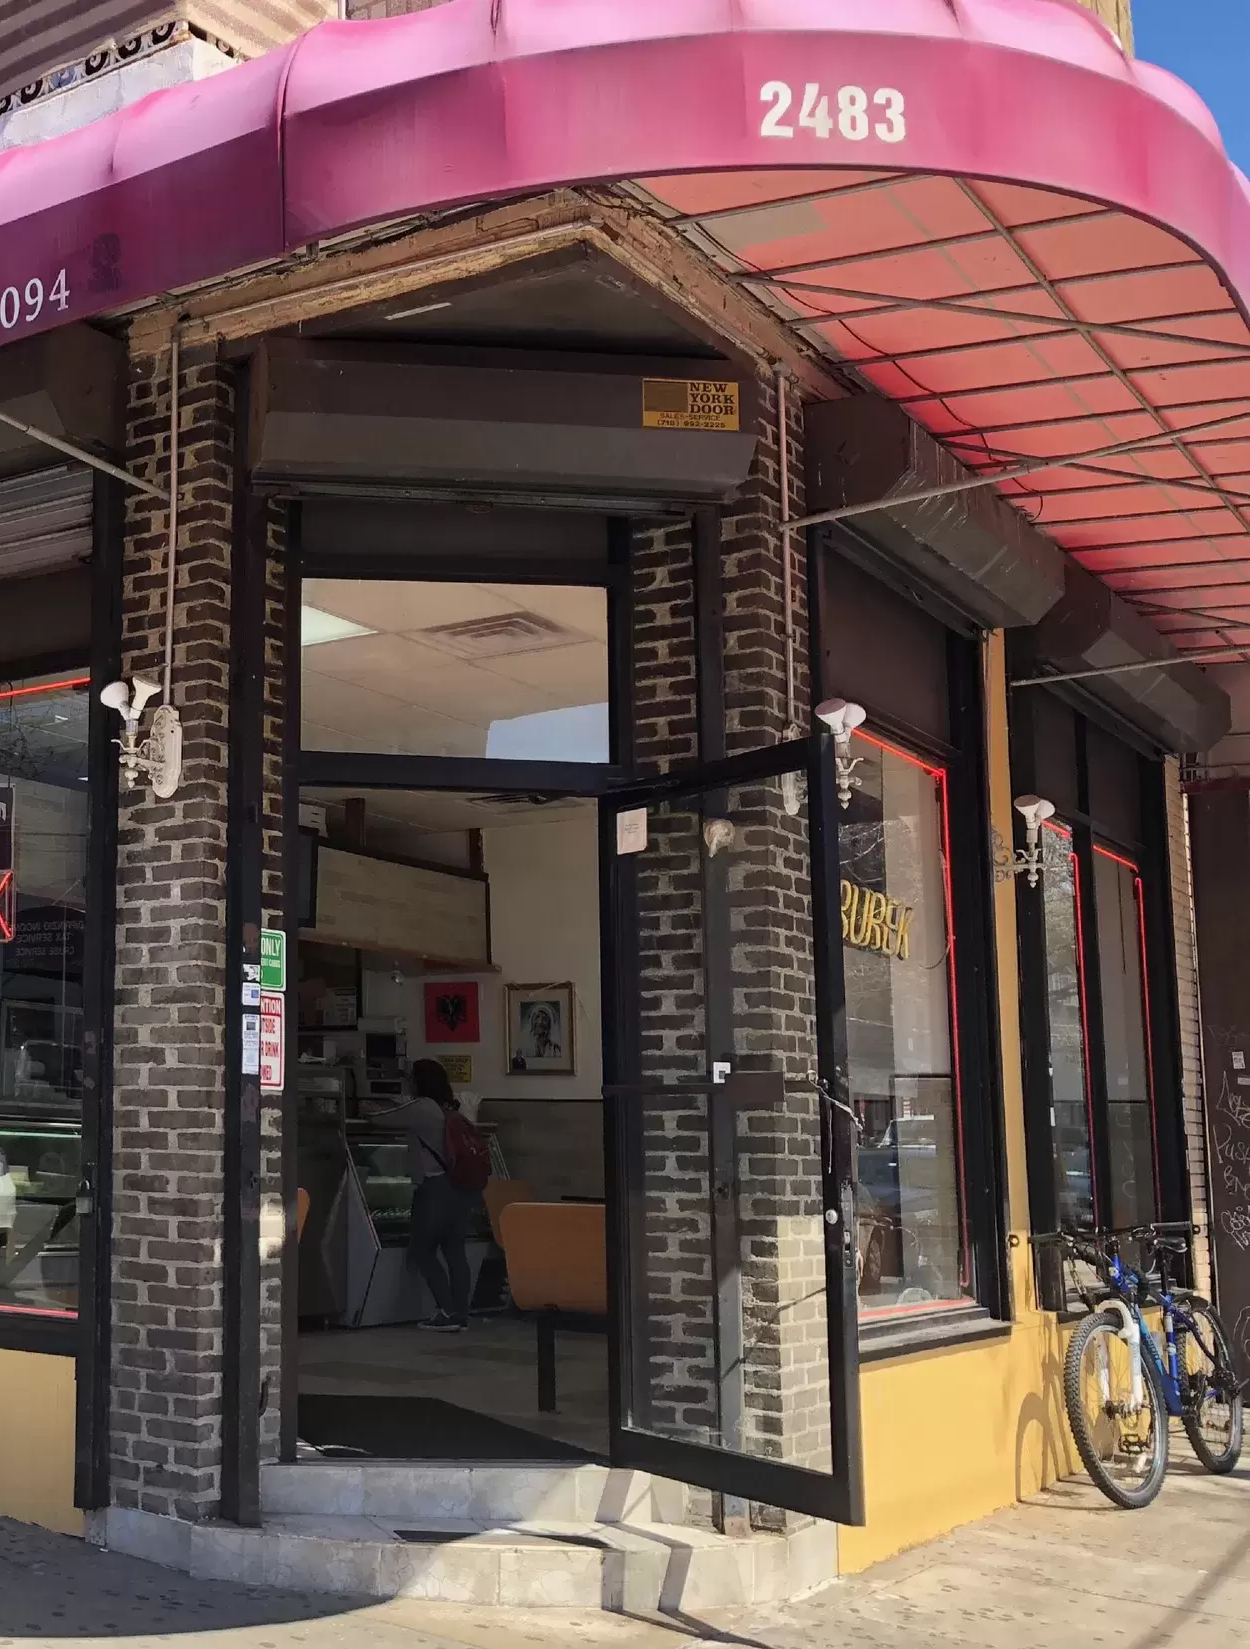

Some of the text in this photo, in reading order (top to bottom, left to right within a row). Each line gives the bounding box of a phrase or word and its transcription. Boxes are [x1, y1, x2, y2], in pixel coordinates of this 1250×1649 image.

[760, 80, 906, 143] 2483
[689, 383, 728, 393] NEW
[689, 393, 735, 404] YORK
[689, 404, 735, 415] DOOR
[261, 937, 281, 957] ONLY
[261, 997, 281, 1014] NTION
